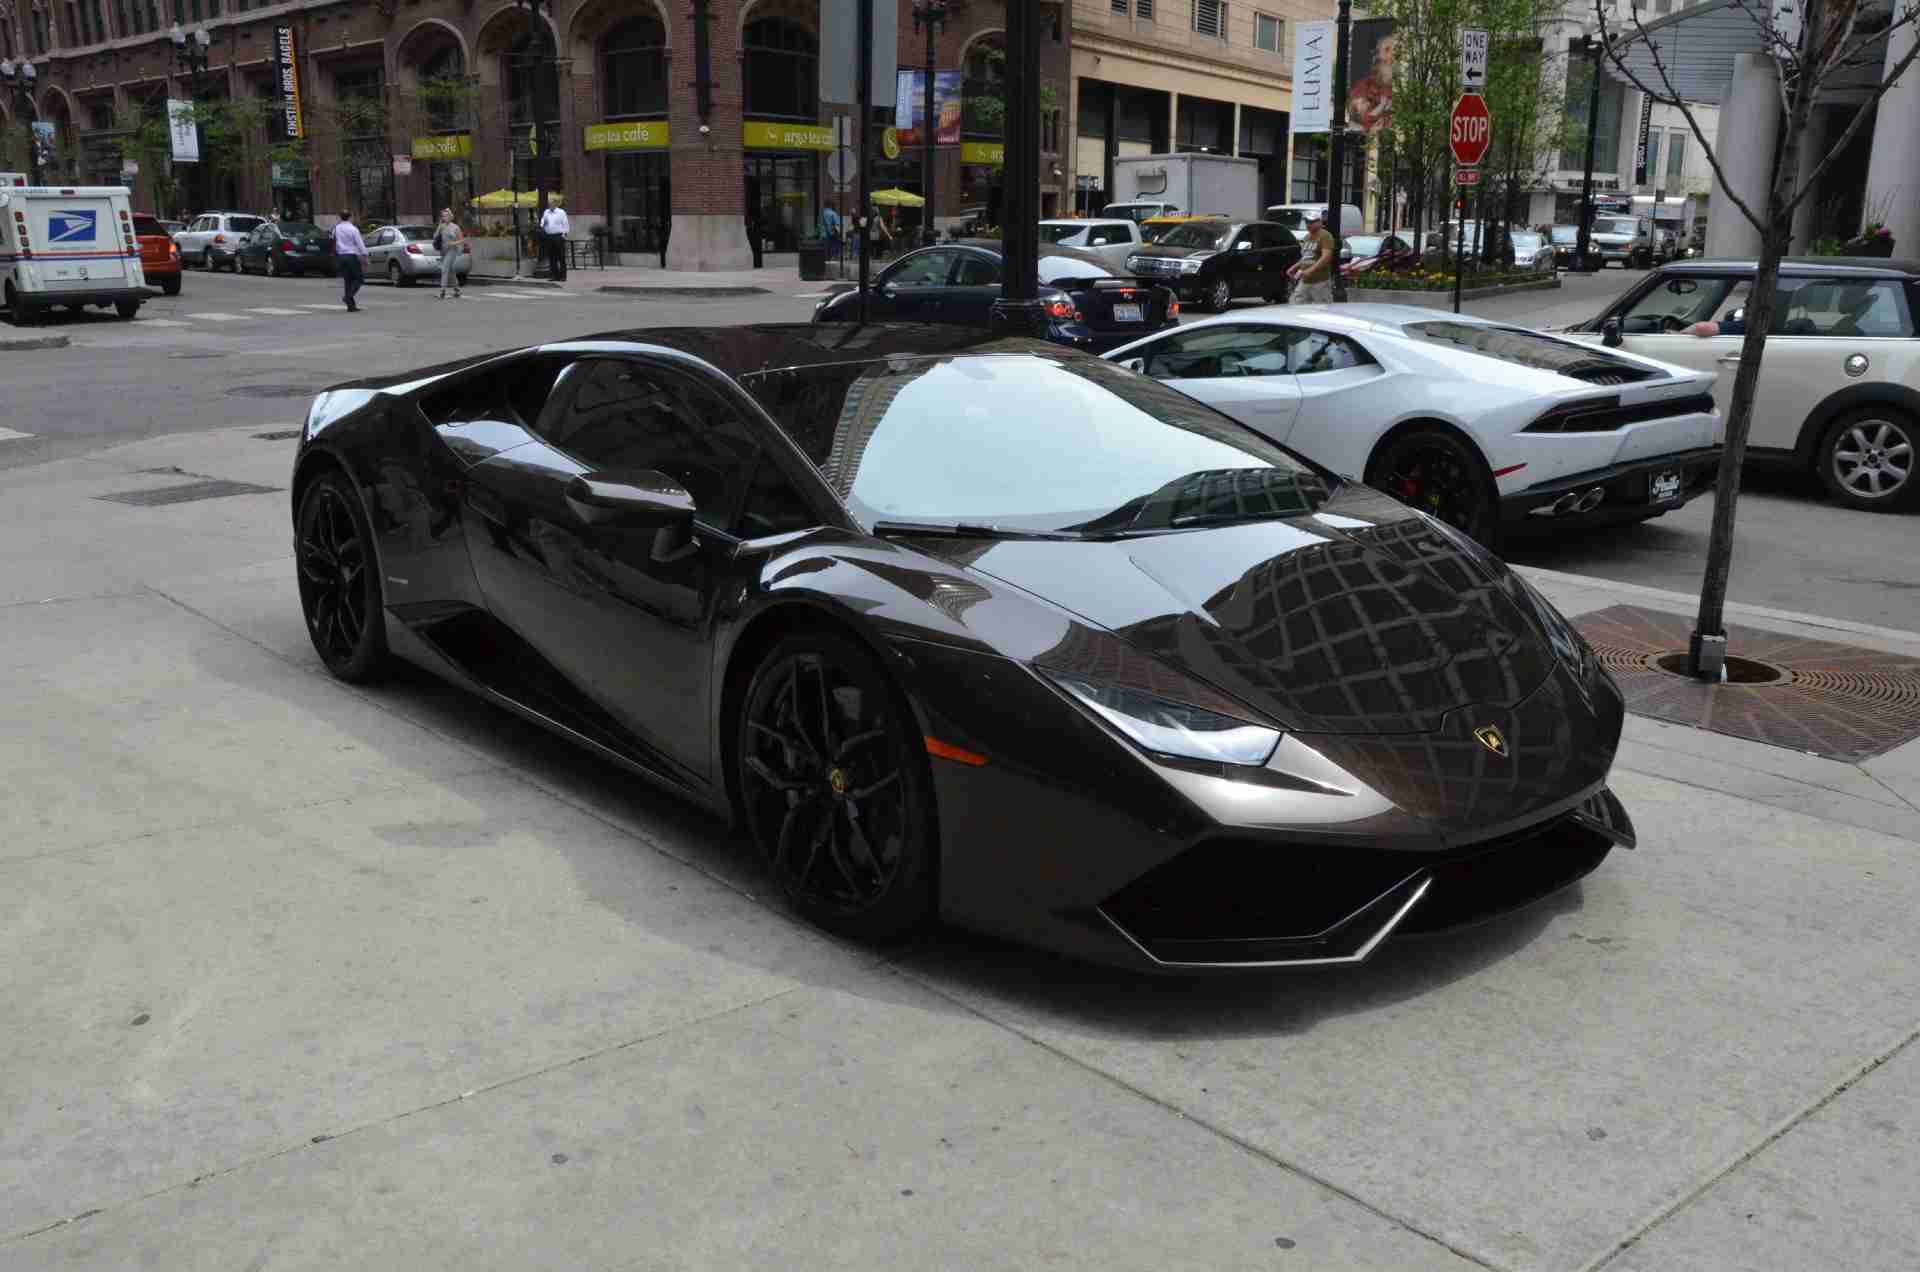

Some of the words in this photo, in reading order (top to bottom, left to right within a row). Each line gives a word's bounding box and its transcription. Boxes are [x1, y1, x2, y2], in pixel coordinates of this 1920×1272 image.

[279, 28, 292, 64] BAGELS
[1465, 34, 1486, 48] ONE
[1465, 51, 1485, 65] WAY
[285, 95, 298, 136] EINSTEIN
[1453, 116, 1487, 143] STOP
[1639, 91, 1652, 144] ORDSTROM
